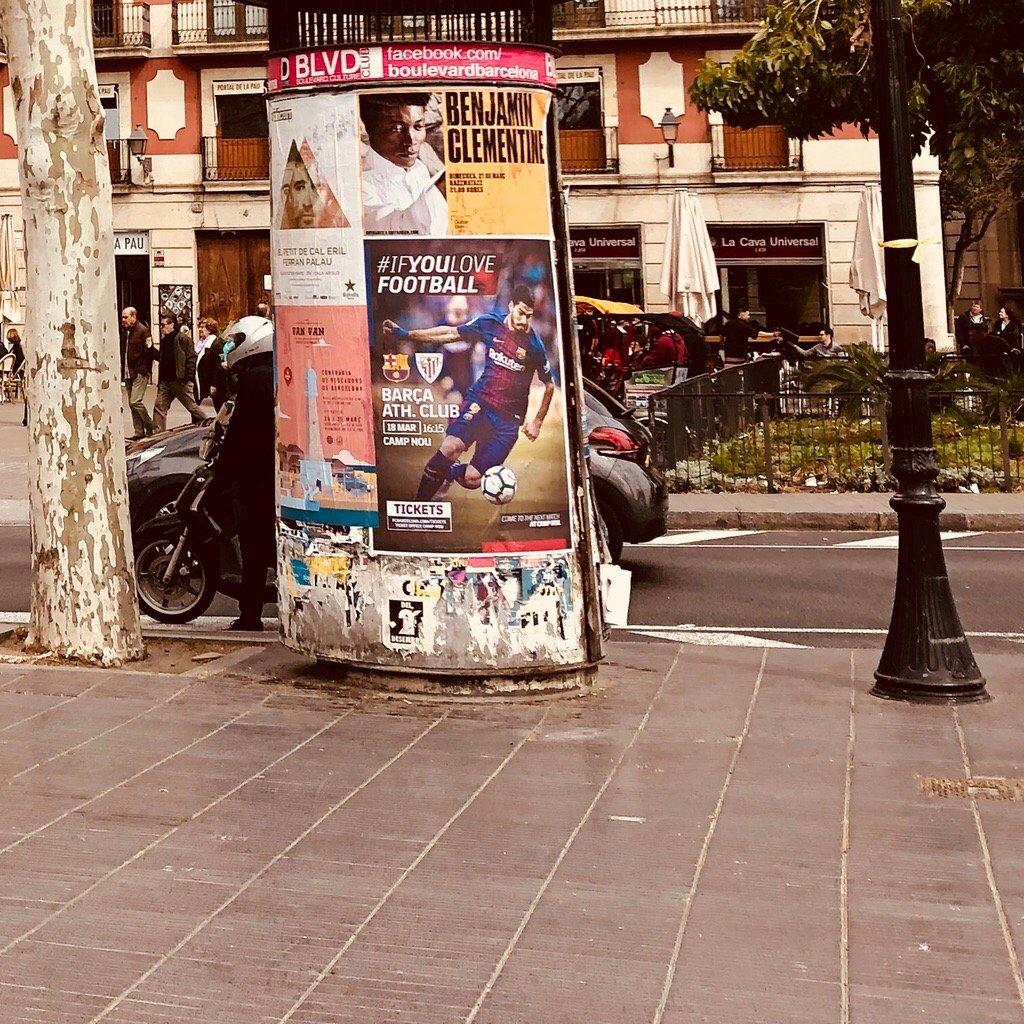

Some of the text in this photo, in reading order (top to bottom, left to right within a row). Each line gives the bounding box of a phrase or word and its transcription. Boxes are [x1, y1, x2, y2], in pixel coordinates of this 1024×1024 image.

[387, 46, 502, 61] facebook.com/
[295, 48, 360, 79] BLVD
[387, 63, 539, 81] boulevardbarcelona
[103, 87, 111, 95] PAU
[217, 83, 234, 91] PORTAL
[251, 82, 261, 90] PAU
[445, 91, 533, 127] BENJAMIN
[447, 128, 545, 164] CLEMENTINE
[114, 237, 144, 250] A PAU
[569, 237, 636, 247] ava Universal
[721, 237, 819, 247] La Cava Universal
[298, 247, 308, 256] DE
[309, 247, 325, 256] CAL
[327, 246, 347, 255] ERIL
[306, 257, 333, 266] PALAU
[376, 255, 497, 274] #IFYOULOVE
[377, 275, 479, 294] FOOTBALL
[381, 387, 435, 405] BARÇA
[382, 403, 461, 418] ATH. CLUB
[386, 423, 417, 432] 18 MAR
[422, 423, 445, 433] 16:15
[383, 436, 432, 447] CAMP NOU
[394, 503, 444, 515] TICKETS
